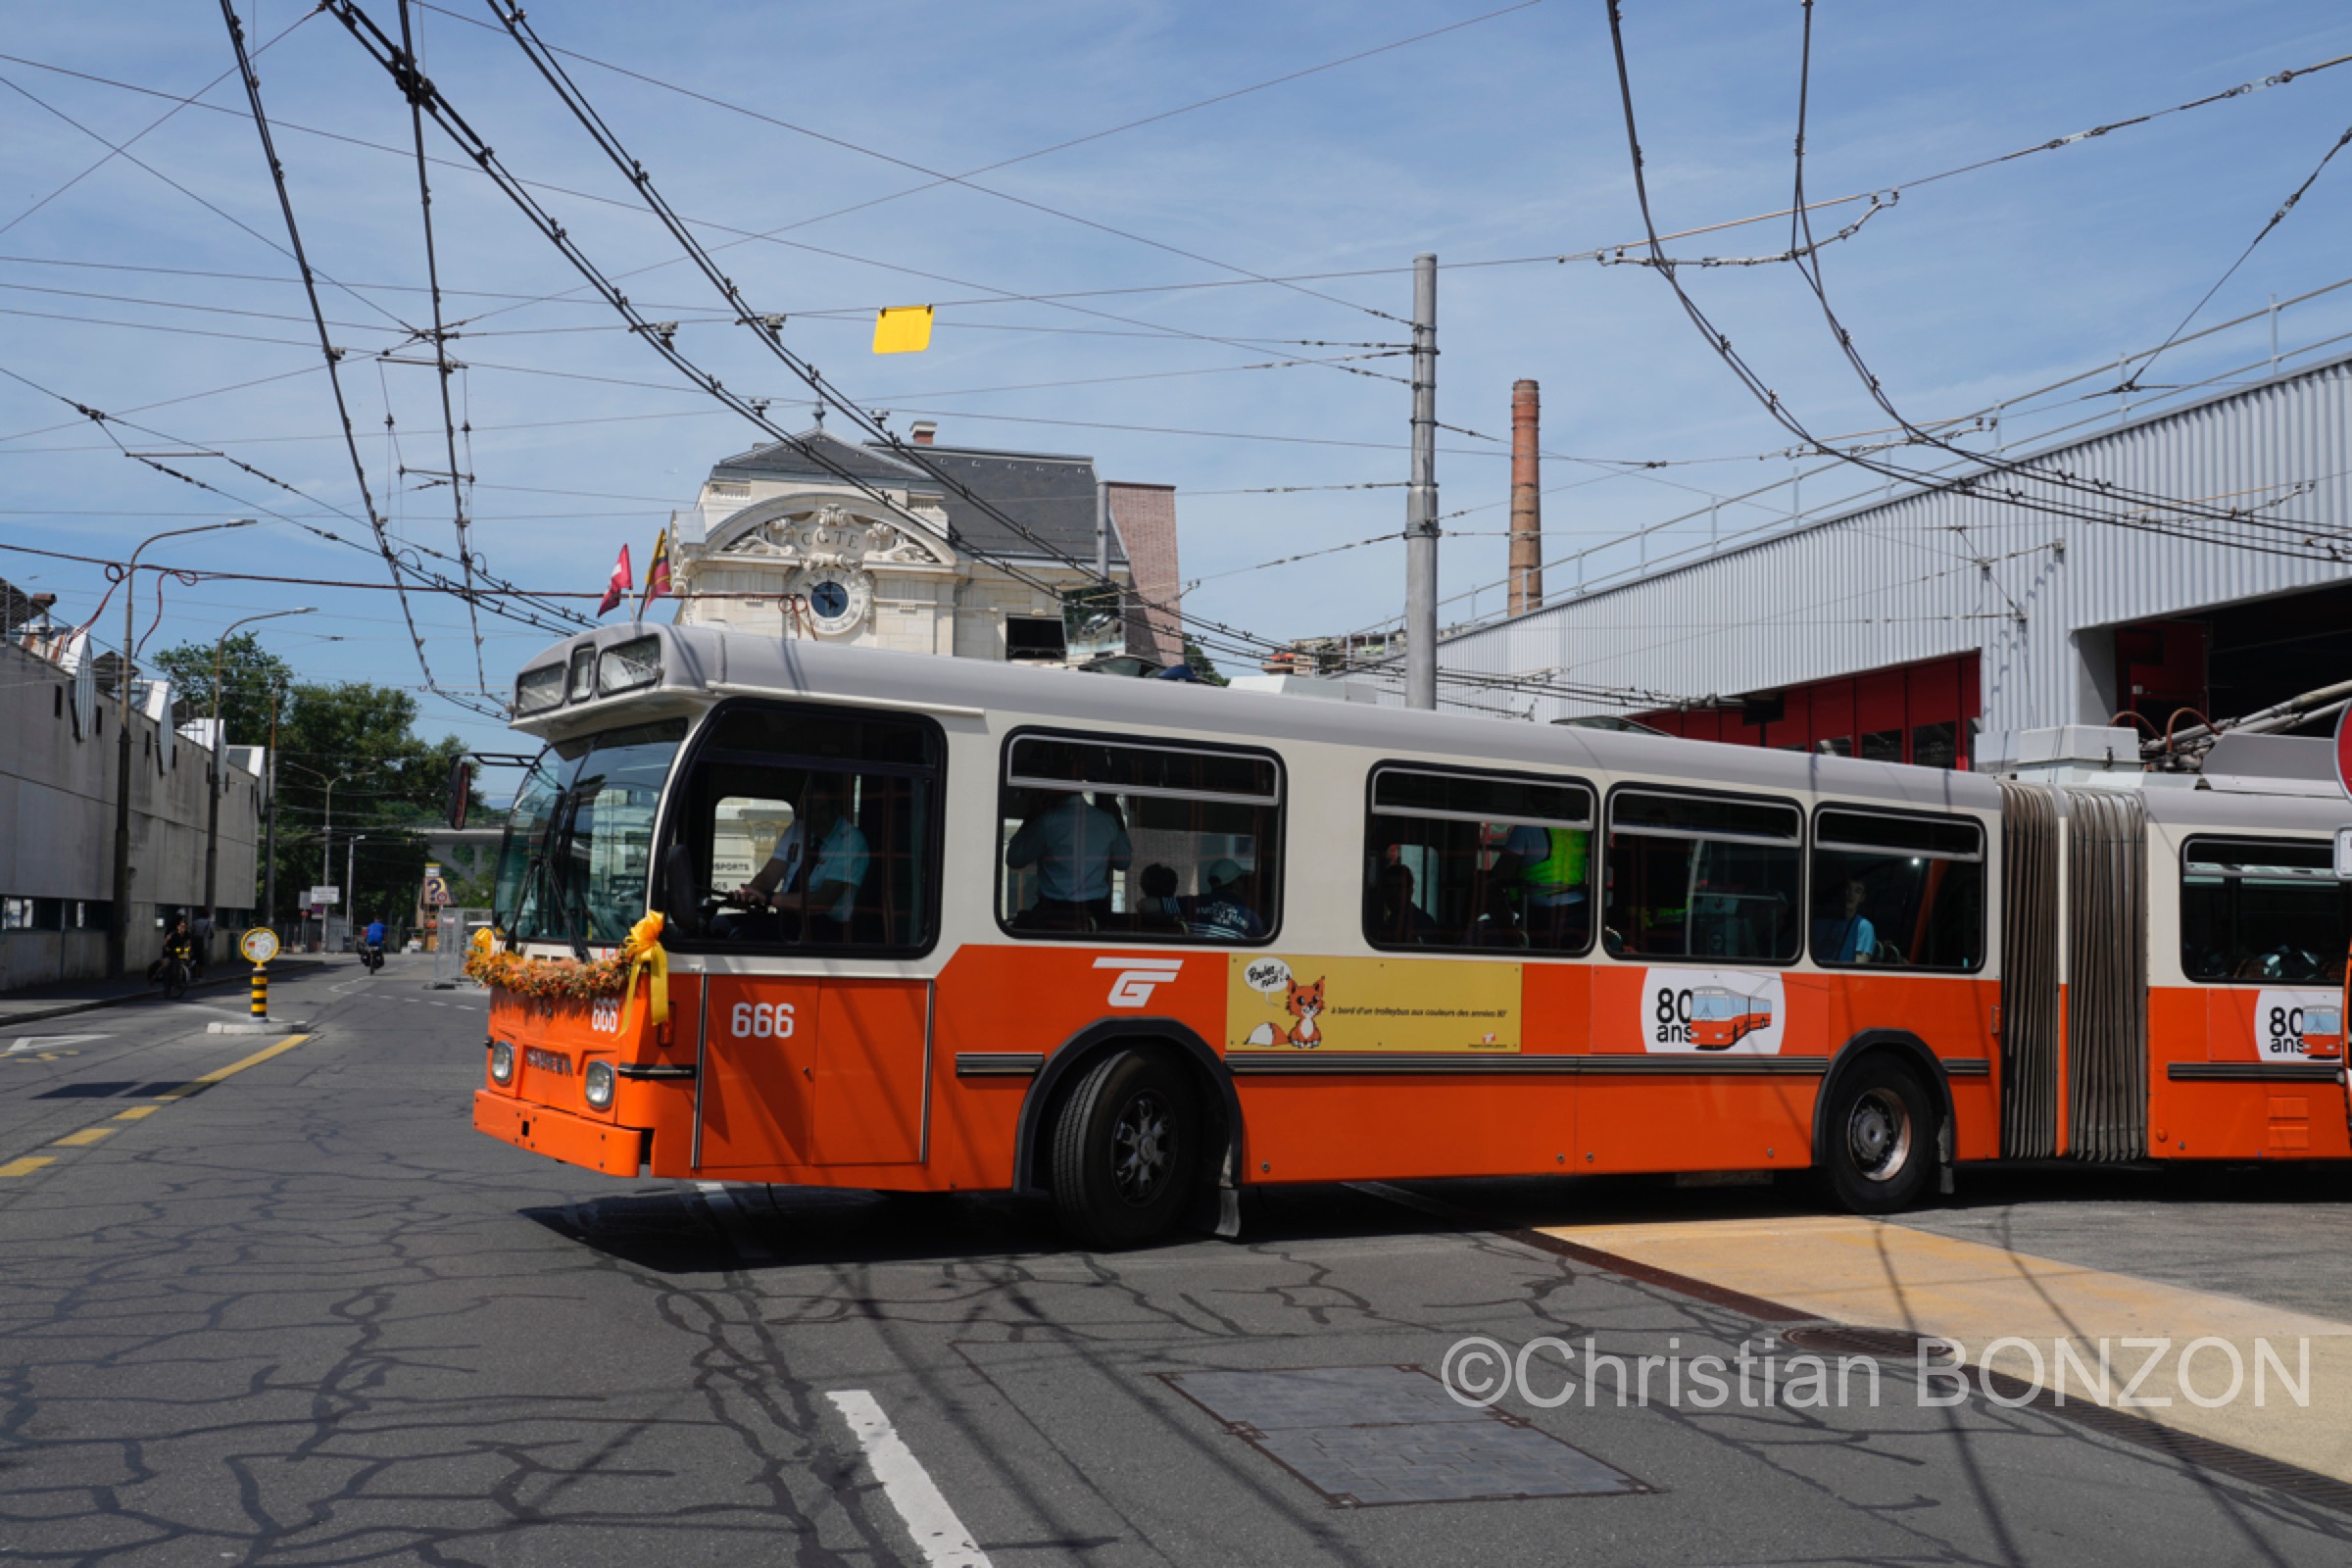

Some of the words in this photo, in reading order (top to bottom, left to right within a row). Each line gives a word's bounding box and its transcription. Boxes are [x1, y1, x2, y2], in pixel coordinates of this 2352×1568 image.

[592, 998, 618, 1033] 666
[731, 1002, 795, 1038] 666
[1338, 1006, 1355, 1015] bord
[1374, 1007, 1409, 1017] trolleybus
[1425, 1008, 1455, 1017] couleurs
[1457, 1008, 1469, 1017] des
[1471, 1008, 1495, 1017] années
